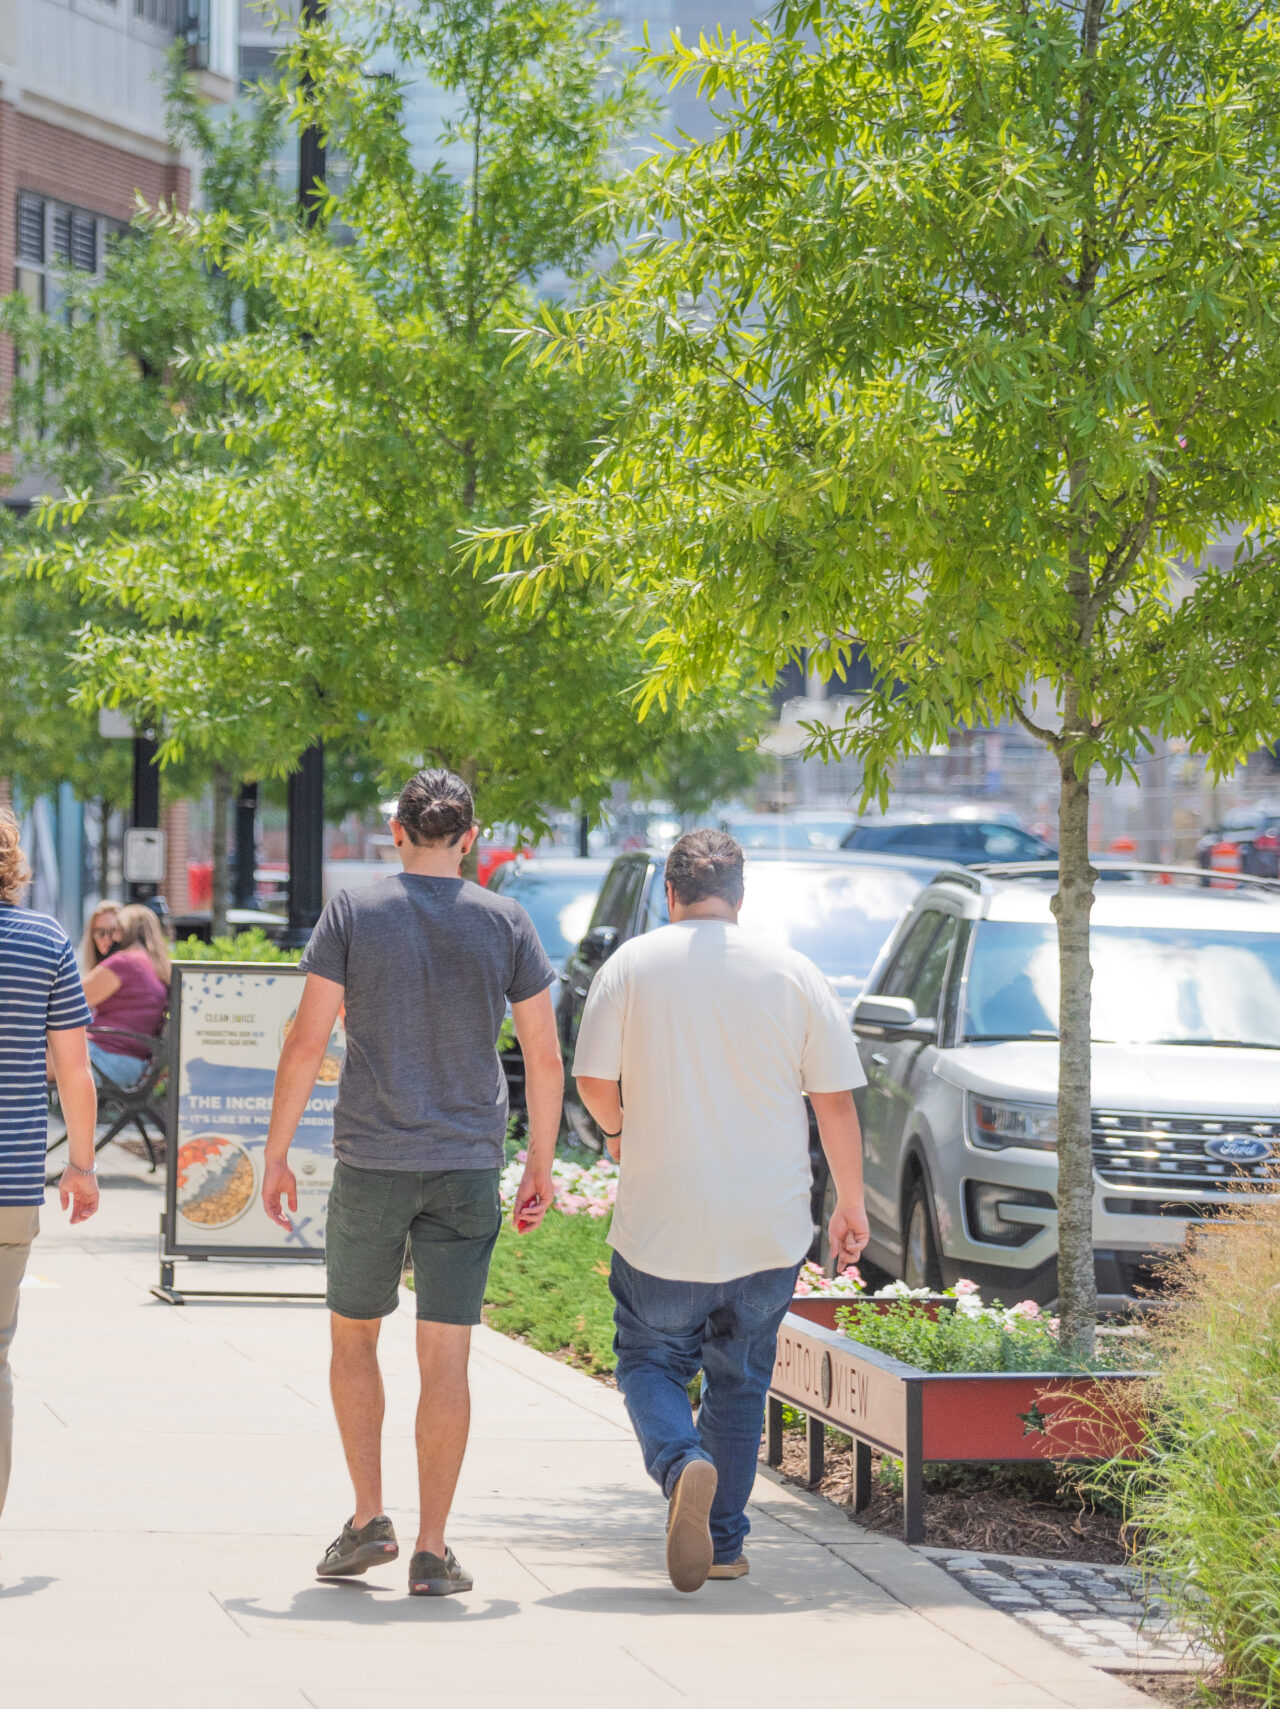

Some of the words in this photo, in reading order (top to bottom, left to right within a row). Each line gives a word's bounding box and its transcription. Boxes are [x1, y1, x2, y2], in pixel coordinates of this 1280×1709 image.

[204, 1013, 229, 1023] CLEAN
[231, 1014, 256, 1024] JUICE
[188, 1095, 222, 1109] THE
[190, 1114, 210, 1124] IT'S
[212, 1115, 236, 1125] LIKE
[254, 1116, 270, 1125] MO
[1220, 1138, 1258, 1156] Ford
[775, 1335, 819, 1398] APITOL
[834, 1361, 869, 1420] VIEW
